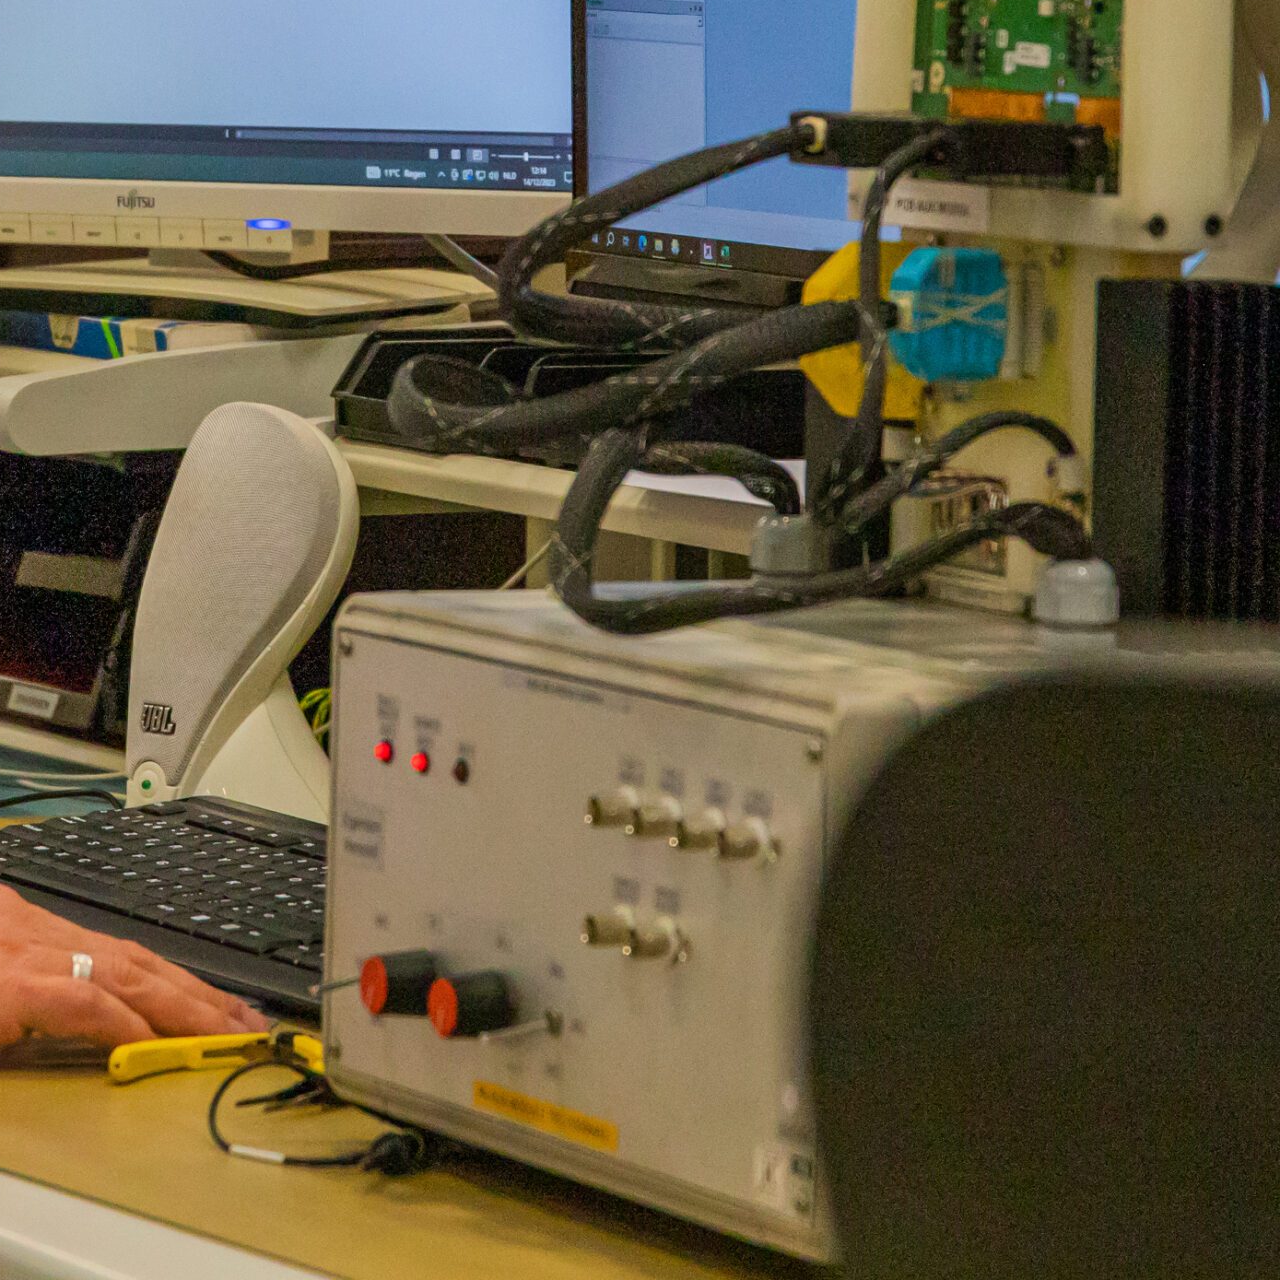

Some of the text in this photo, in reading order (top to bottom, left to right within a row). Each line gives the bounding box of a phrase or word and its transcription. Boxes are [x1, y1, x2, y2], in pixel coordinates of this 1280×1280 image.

[404, 169, 427, 181] Regen
[503, 171, 517, 180] NLD
[116, 191, 155, 210] FUJITSU
[141, 702, 176, 735] JBL
